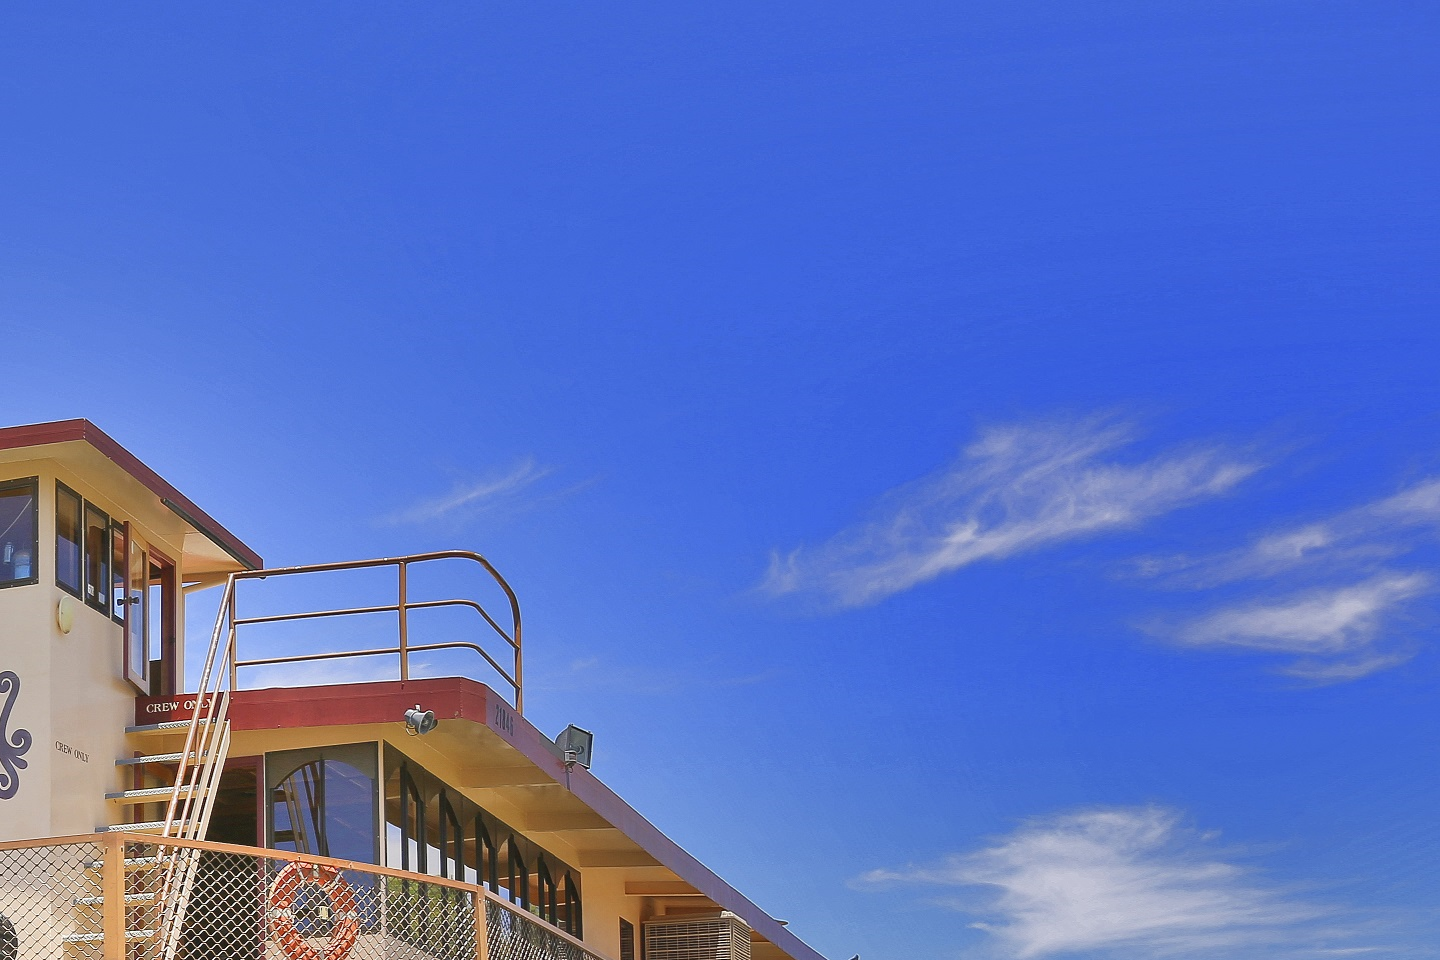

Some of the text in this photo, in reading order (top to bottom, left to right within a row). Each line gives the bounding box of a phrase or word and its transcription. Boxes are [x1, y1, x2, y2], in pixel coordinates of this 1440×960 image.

[146, 702, 179, 713] CREW
[55, 740, 90, 763] CREW ONLY
